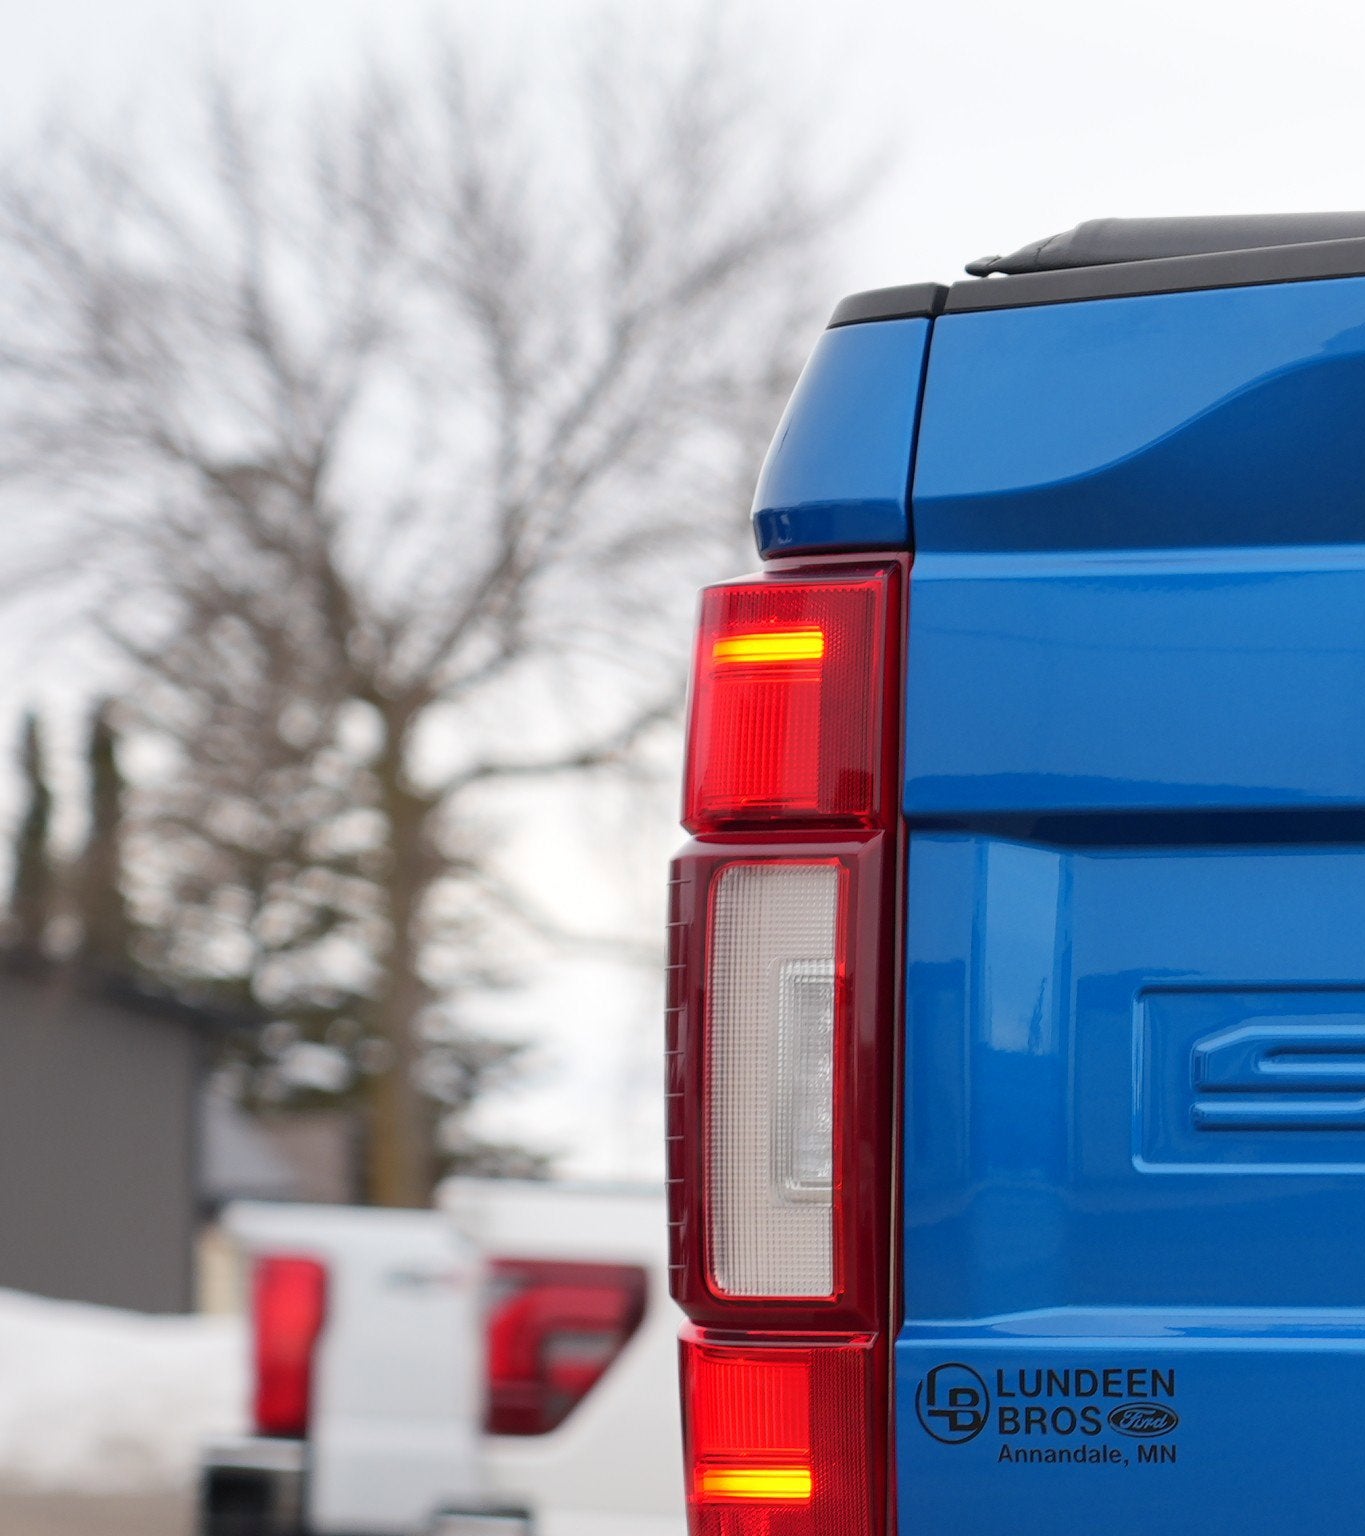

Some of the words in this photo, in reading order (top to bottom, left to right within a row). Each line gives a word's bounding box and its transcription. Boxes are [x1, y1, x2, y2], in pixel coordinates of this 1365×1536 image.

[996, 1368, 1175, 1398] LUNDEEN
[998, 1406, 1102, 1436] BROS
[1120, 1410, 1169, 1429] Ford
[997, 1445, 1129, 1467] Annandale,
[1137, 1445, 1177, 1463] MN
